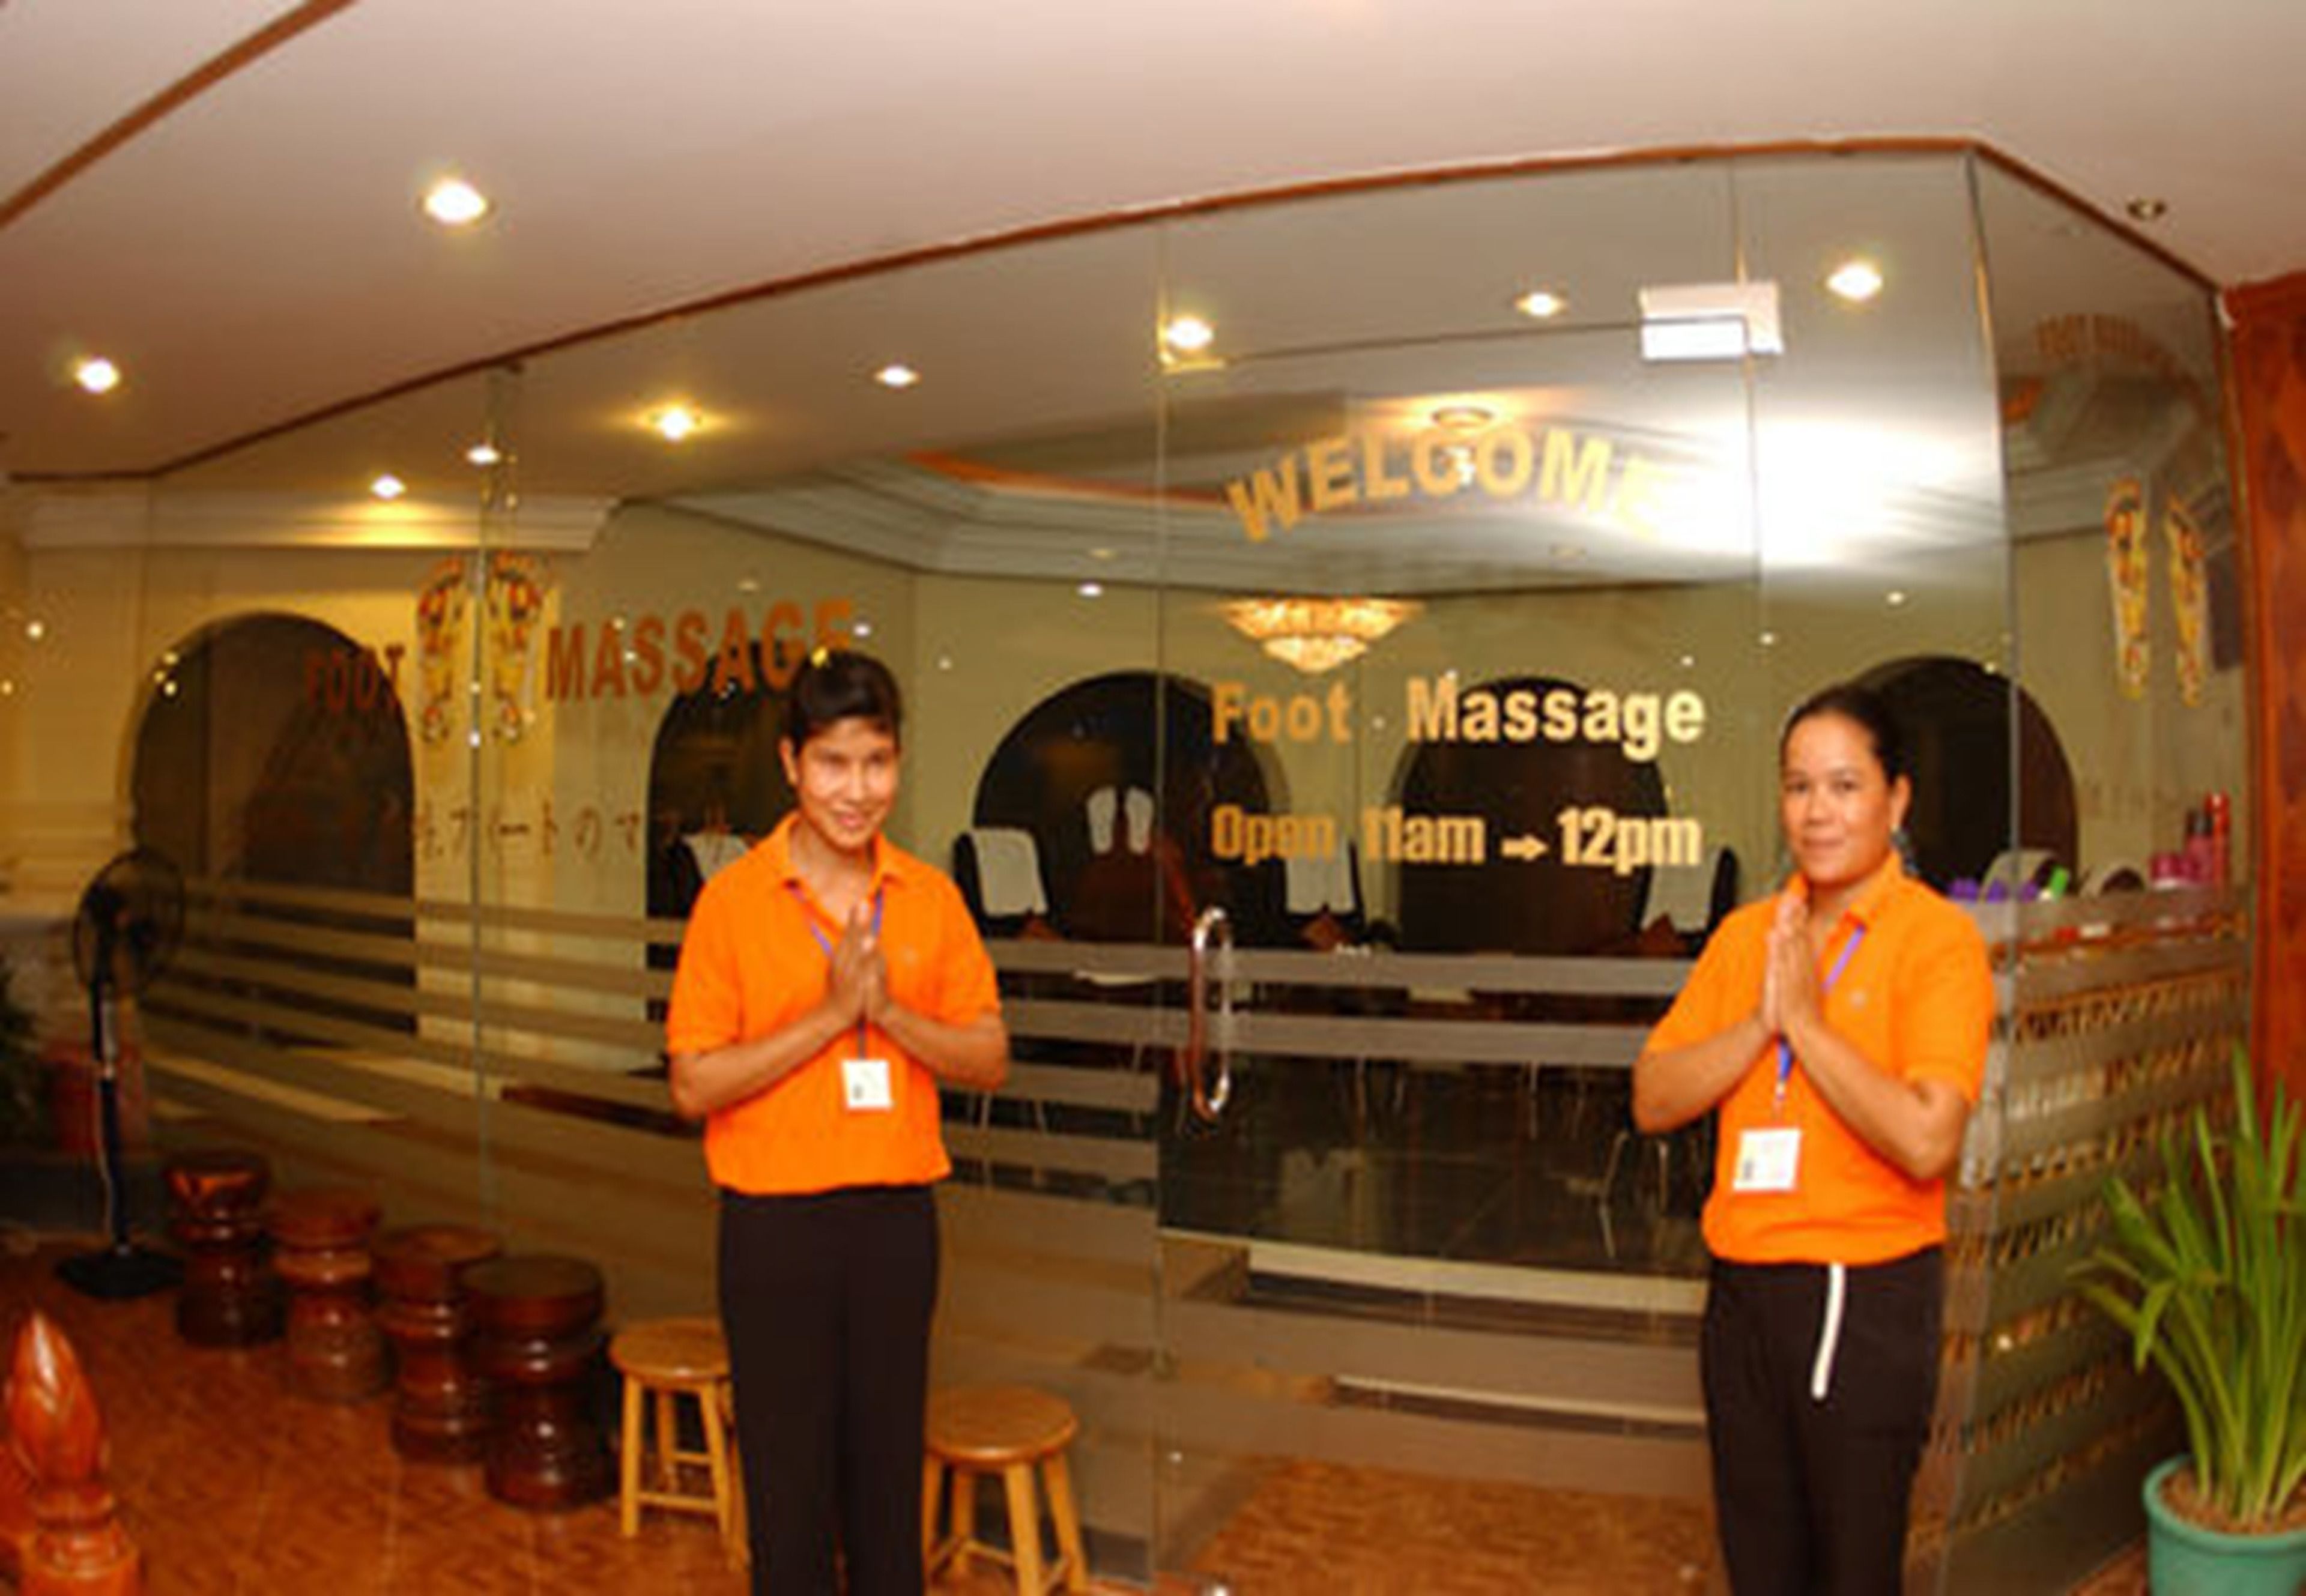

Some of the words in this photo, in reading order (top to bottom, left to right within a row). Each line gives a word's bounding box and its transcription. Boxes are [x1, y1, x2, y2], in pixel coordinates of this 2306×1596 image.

[1226, 429, 1665, 543] WELCOME
[305, 642, 406, 715] FOOT
[1212, 682, 1352, 745] Foot
[1406, 676, 1705, 761] Massage
[1212, 805, 1336, 866] Open
[1362, 806, 1486, 863] 11am
[1557, 806, 1702, 875] 12pm
